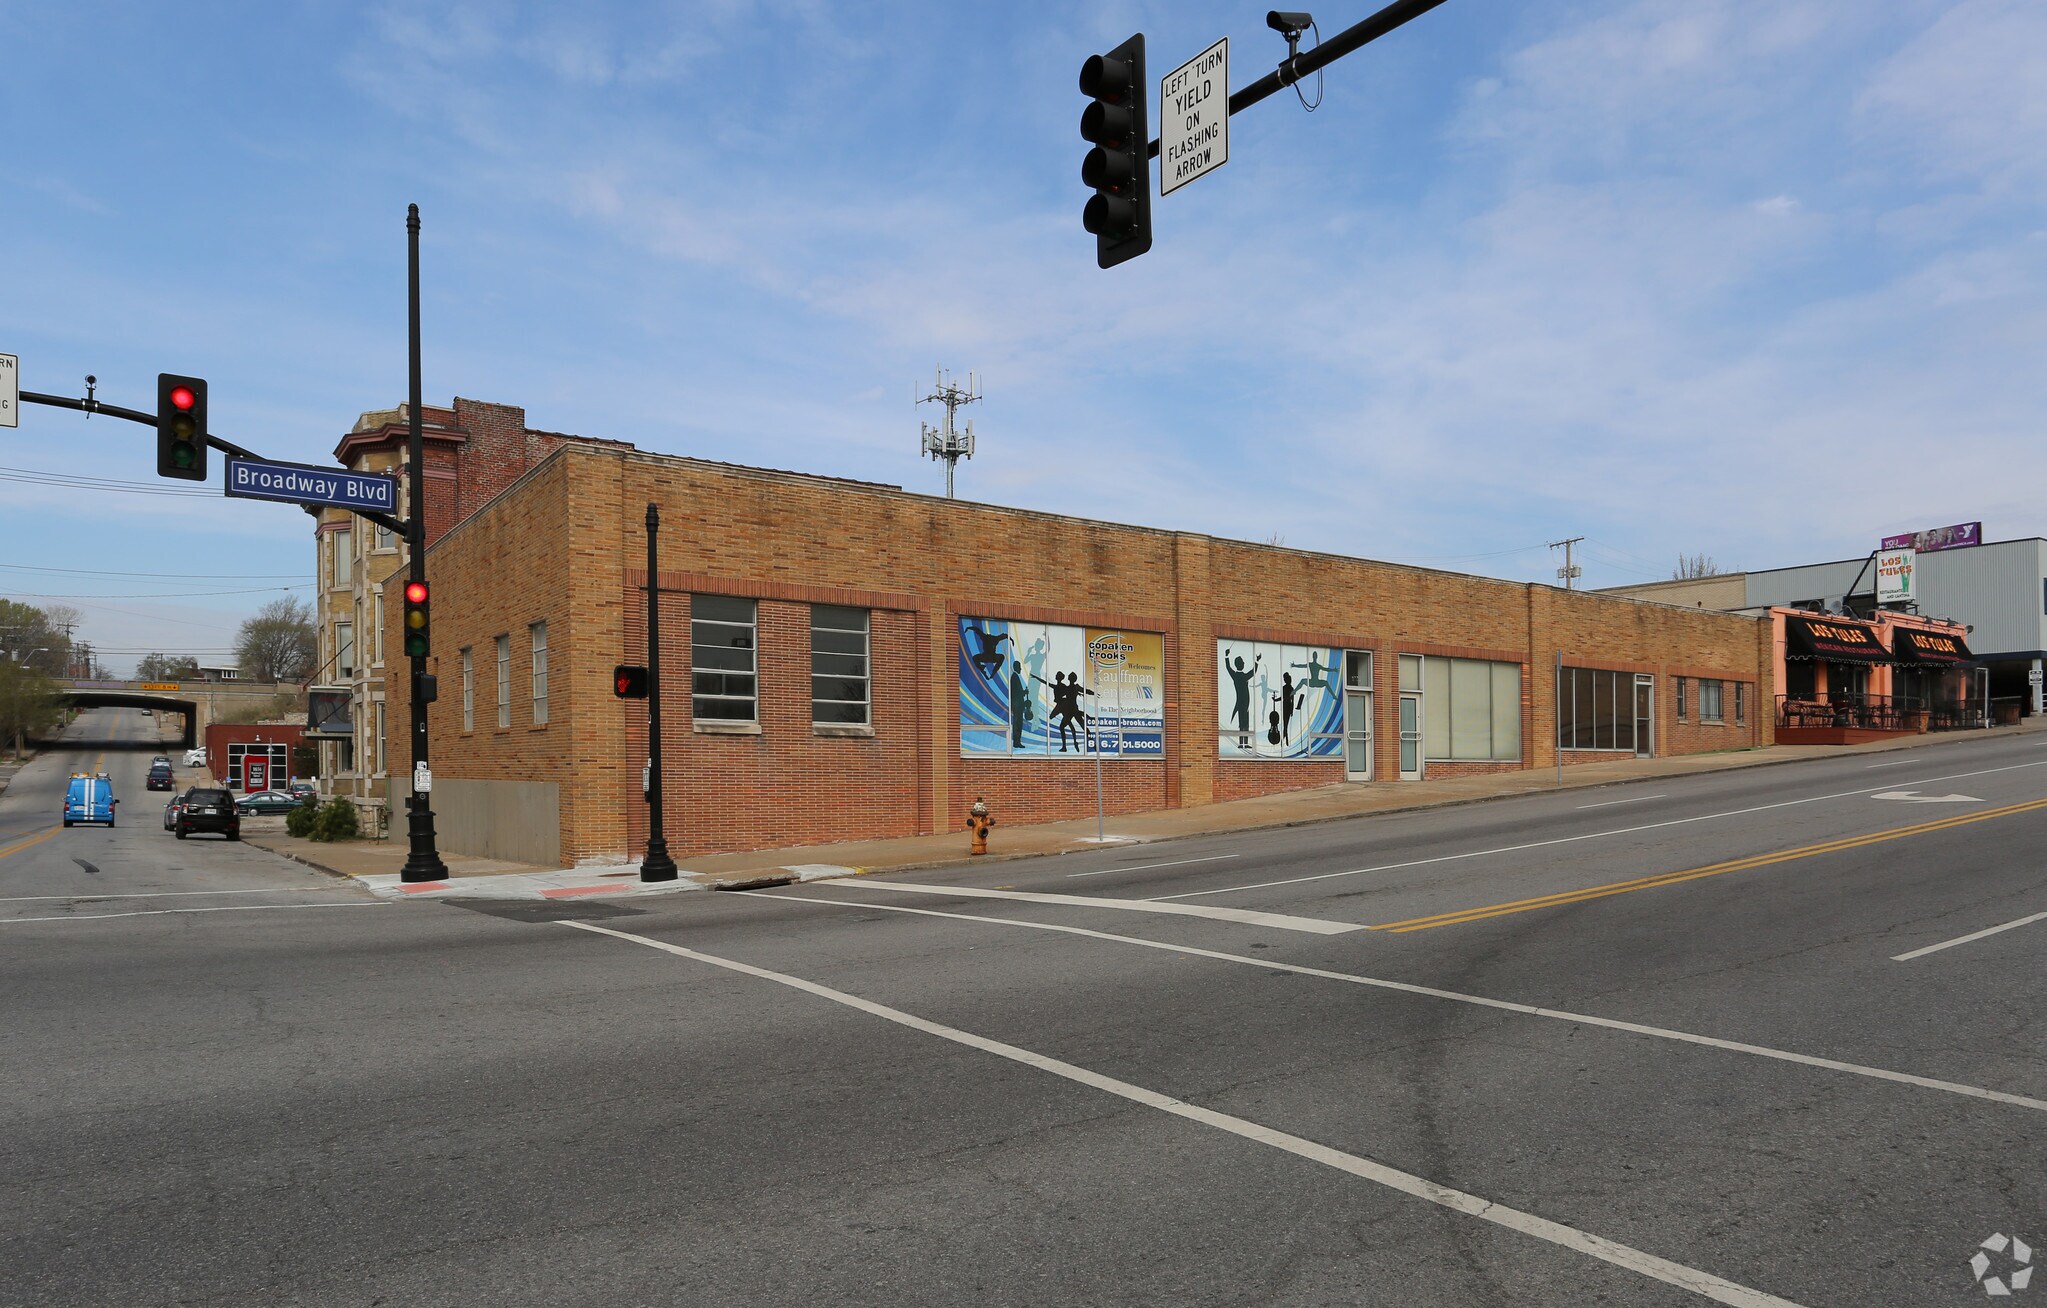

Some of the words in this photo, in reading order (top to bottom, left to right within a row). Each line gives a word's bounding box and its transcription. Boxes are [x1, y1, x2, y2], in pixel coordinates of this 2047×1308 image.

[1166, 71, 1188, 98] LEFT
[1196, 49, 1223, 78] TURN
[1175, 79, 1211, 115] YIELD
[1186, 110, 1200, 131] ON
[1169, 122, 1218, 163] FLASHING
[1176, 147, 1212, 180] ARROW
[0, 359, 13, 369] RN
[237, 467, 337, 499] Broadway
[347, 480, 387, 501] Blvd
[1884, 539, 1899, 547] YOU
[1881, 557, 1901, 567] LOS
[1879, 565, 1912, 576] TULES
[1806, 622, 1833, 638] LOS
[1830, 626, 1868, 643] TULES
[1089, 642, 1133, 652] copaken
[1910, 633, 1931, 648] LOS
[1928, 637, 1957, 653] TULES
[1089, 650, 1126, 661] brooks
[1128, 663, 1156, 671] Welcomes
[1087, 740, 1160, 749] 86.701.5000
